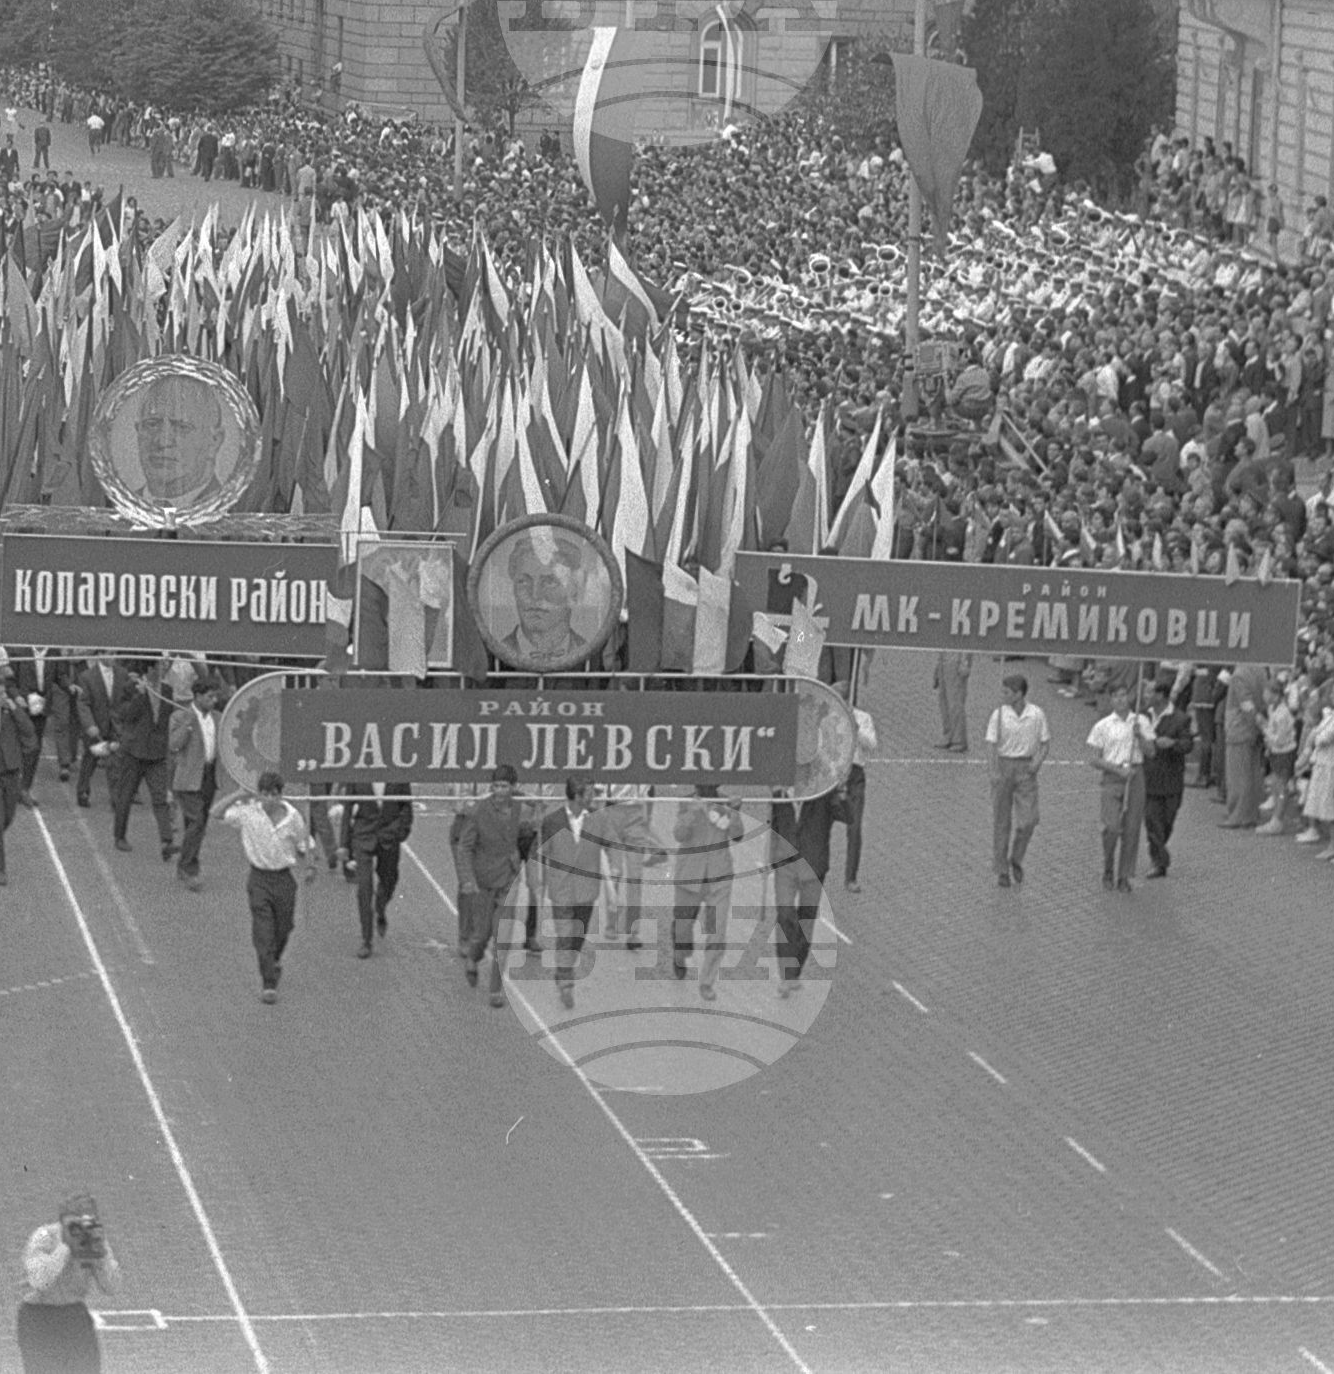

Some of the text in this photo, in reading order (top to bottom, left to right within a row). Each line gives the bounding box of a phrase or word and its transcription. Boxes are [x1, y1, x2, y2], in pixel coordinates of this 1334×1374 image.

[1022, 580, 1108, 598] РАЙОН
[851, 593, 1252, 649] МК-КРЕМИКОВЦИ
[478, 696, 607, 717] РАЙОН
[296, 720, 776, 773] „ВАСИЛ ЛЕВСКИ“
